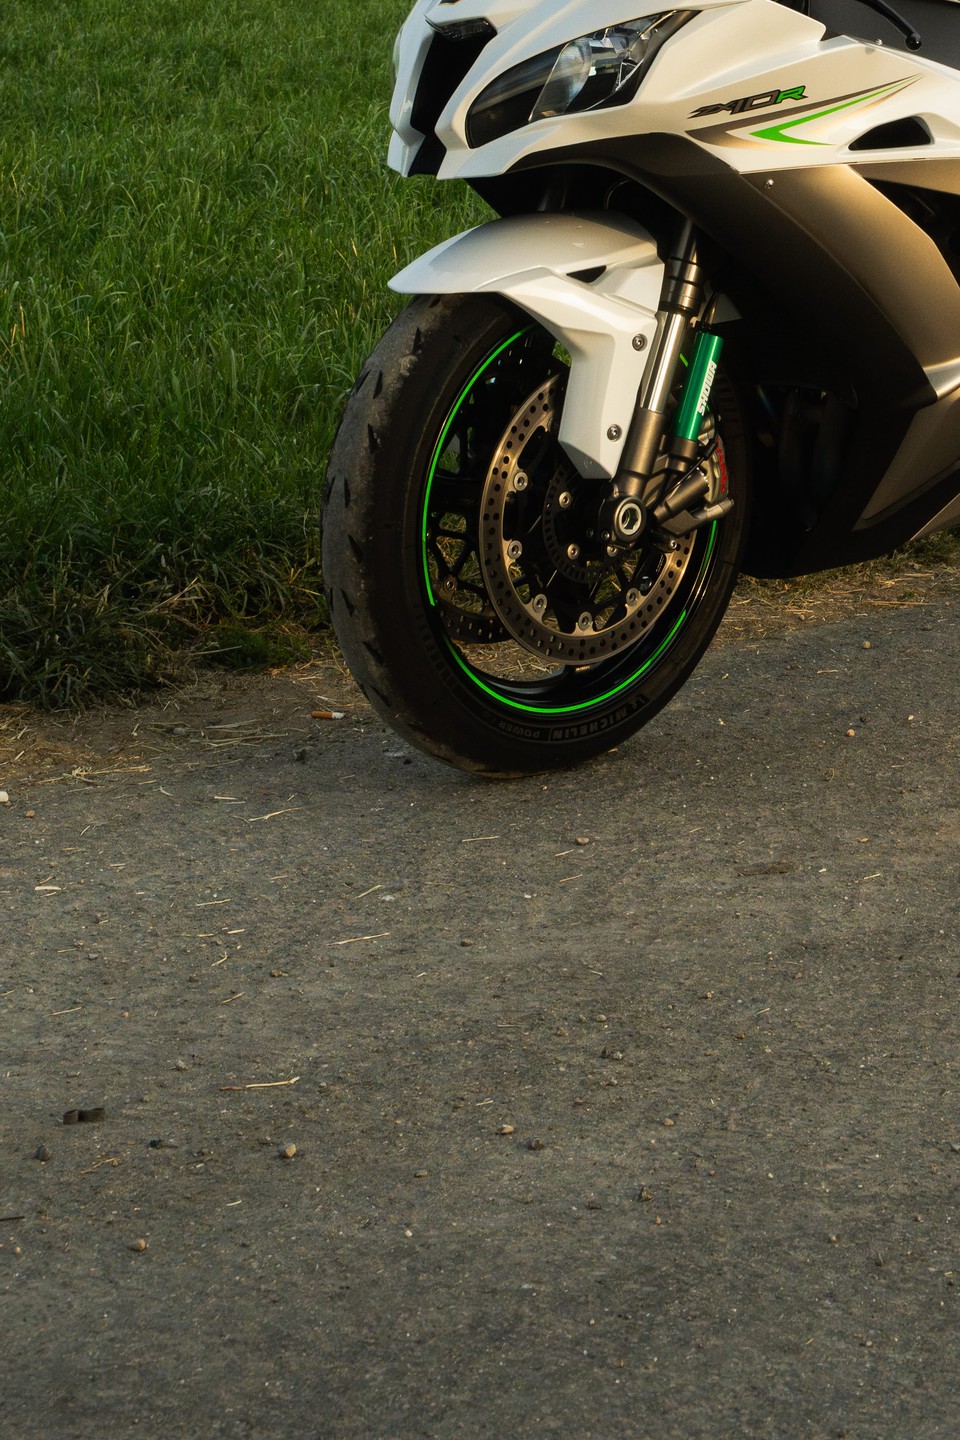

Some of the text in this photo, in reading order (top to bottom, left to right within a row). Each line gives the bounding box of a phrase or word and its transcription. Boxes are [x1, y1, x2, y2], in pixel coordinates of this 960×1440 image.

[697, 359, 717, 417] SHOWA
[498, 703, 630, 740] MICHELIN POWER
